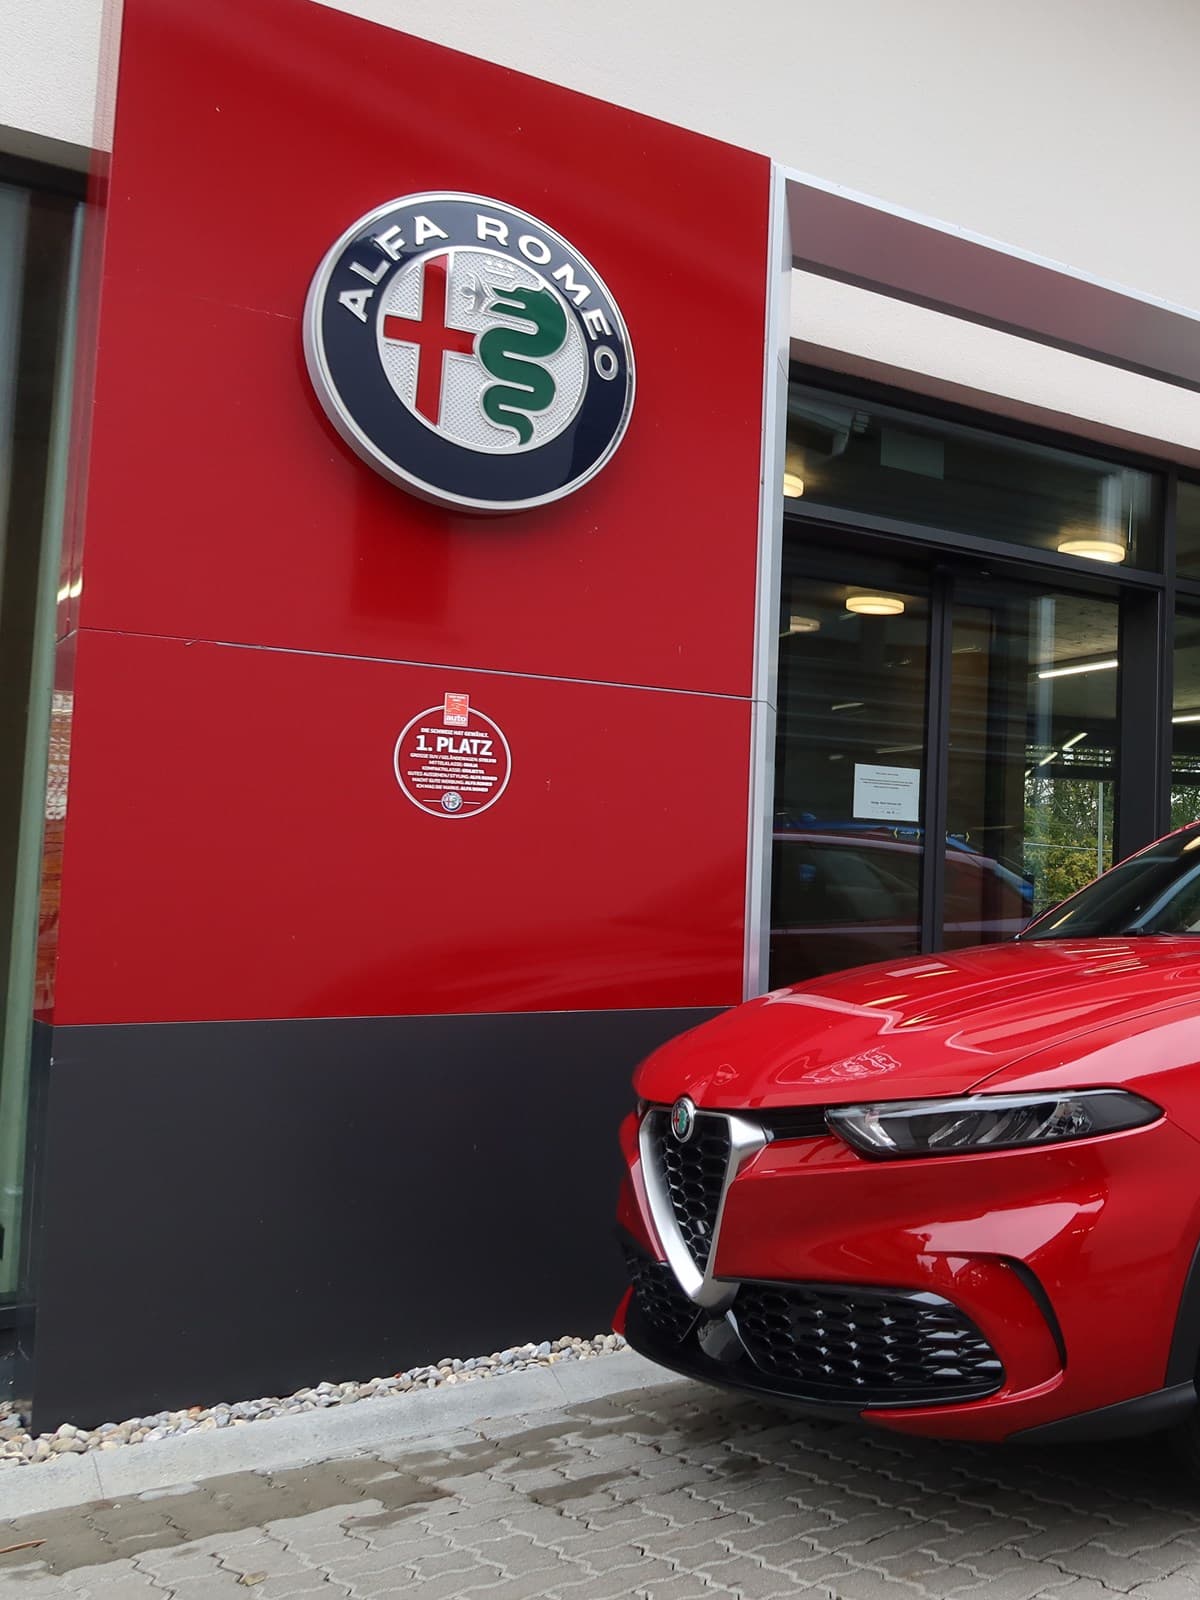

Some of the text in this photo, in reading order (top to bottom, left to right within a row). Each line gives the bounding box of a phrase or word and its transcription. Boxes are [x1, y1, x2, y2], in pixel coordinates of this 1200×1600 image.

[338, 214, 619, 381] ALFA ROMEO
[415, 735, 493, 756] 1. PLATZ
